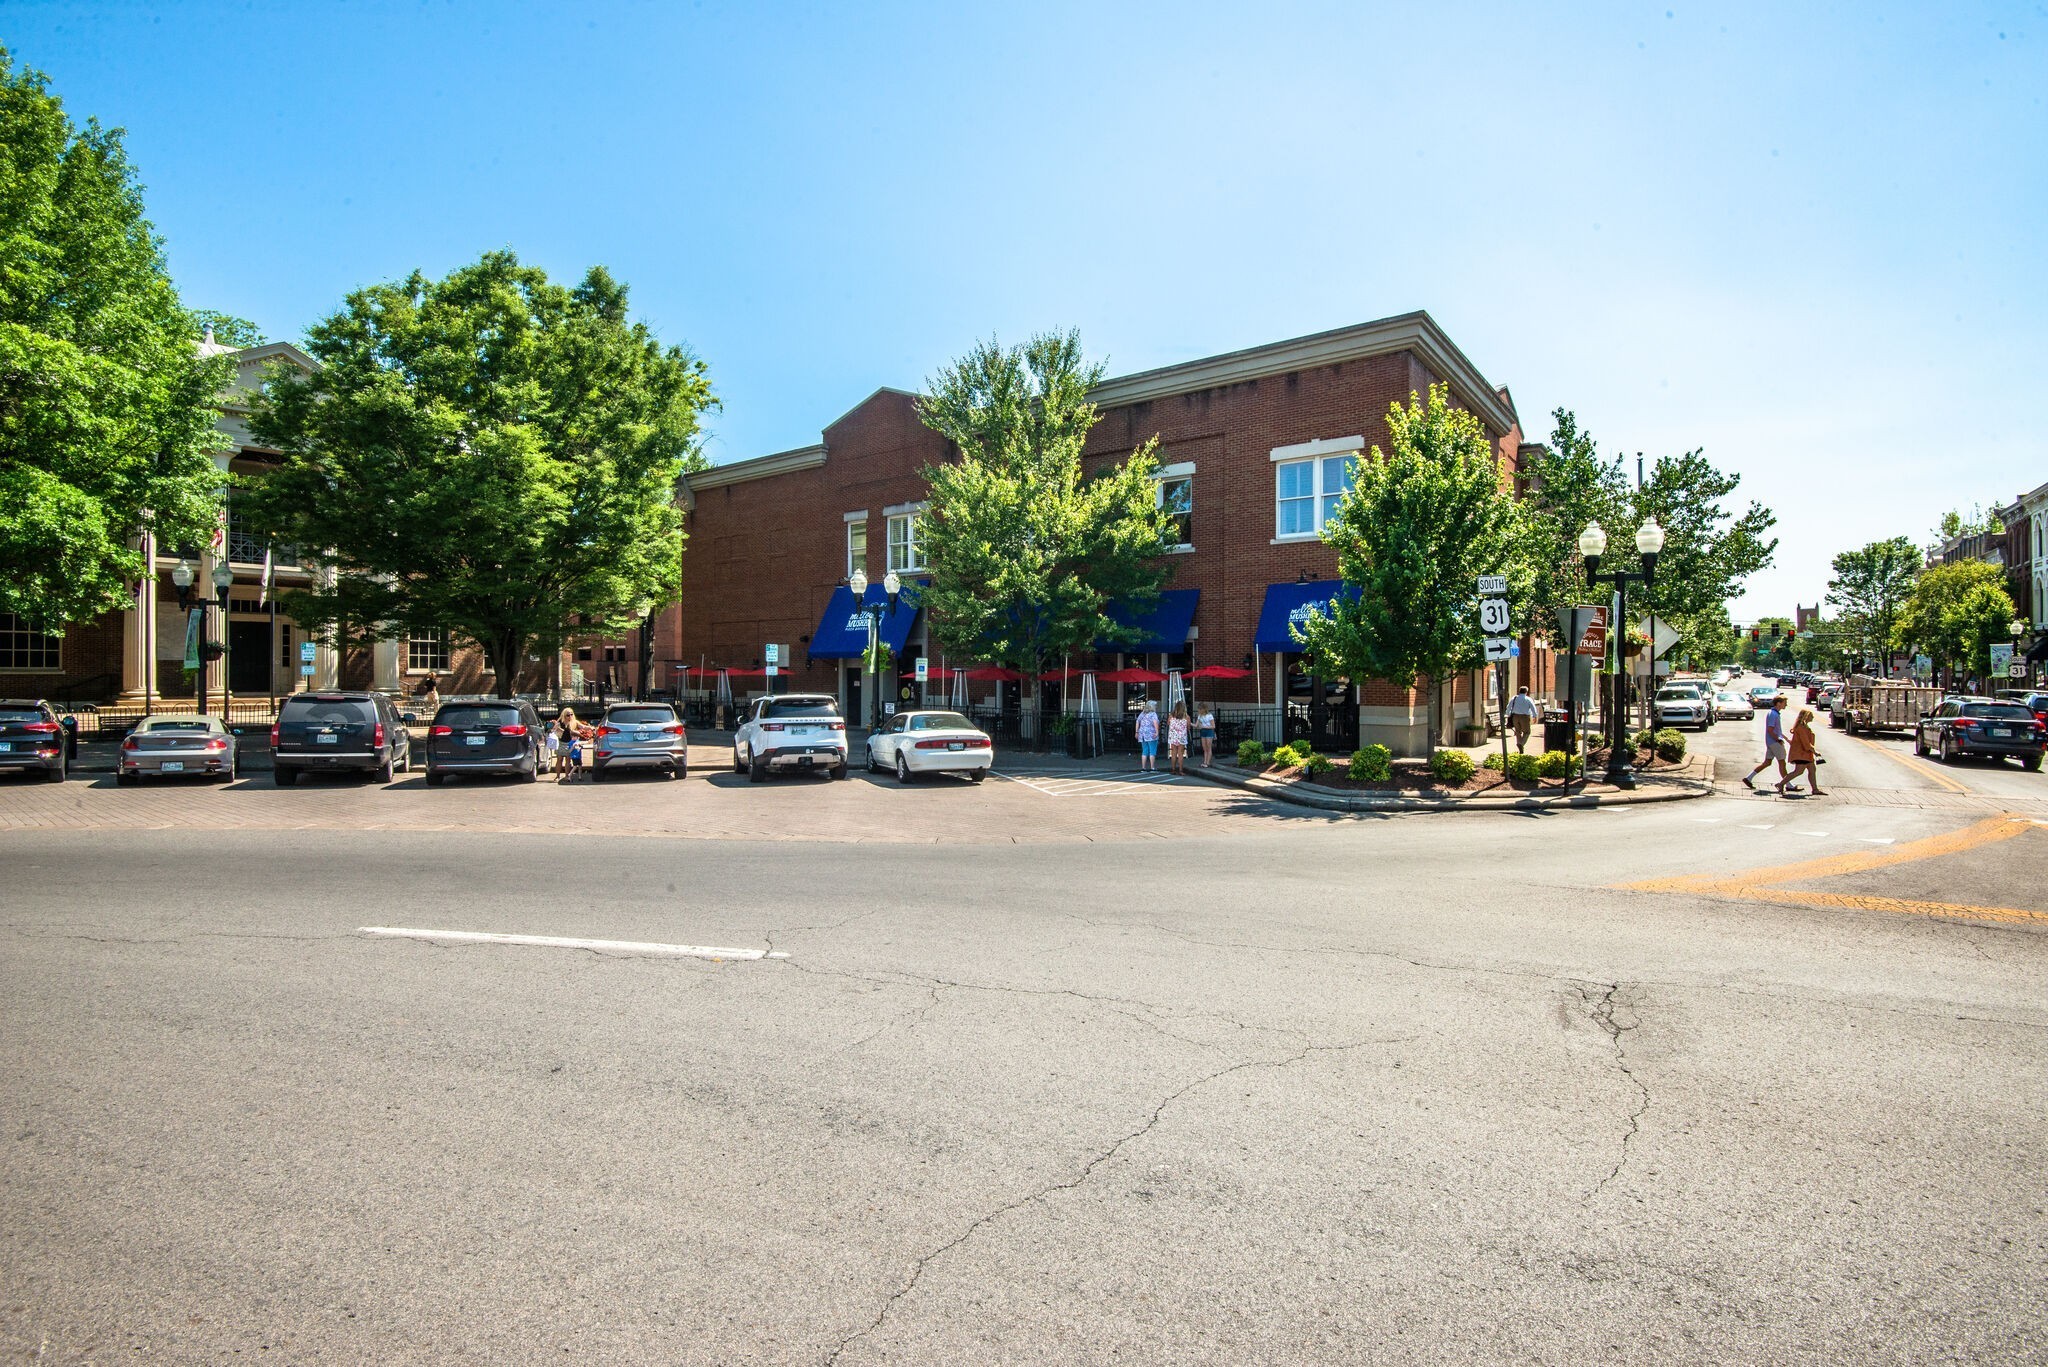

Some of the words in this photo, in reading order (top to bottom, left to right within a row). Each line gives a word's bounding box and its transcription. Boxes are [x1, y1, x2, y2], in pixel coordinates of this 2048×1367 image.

[1479, 578, 1505, 590] SOUTH
[1486, 605, 1504, 625] 31
[2012, 666, 2024, 676] 31
